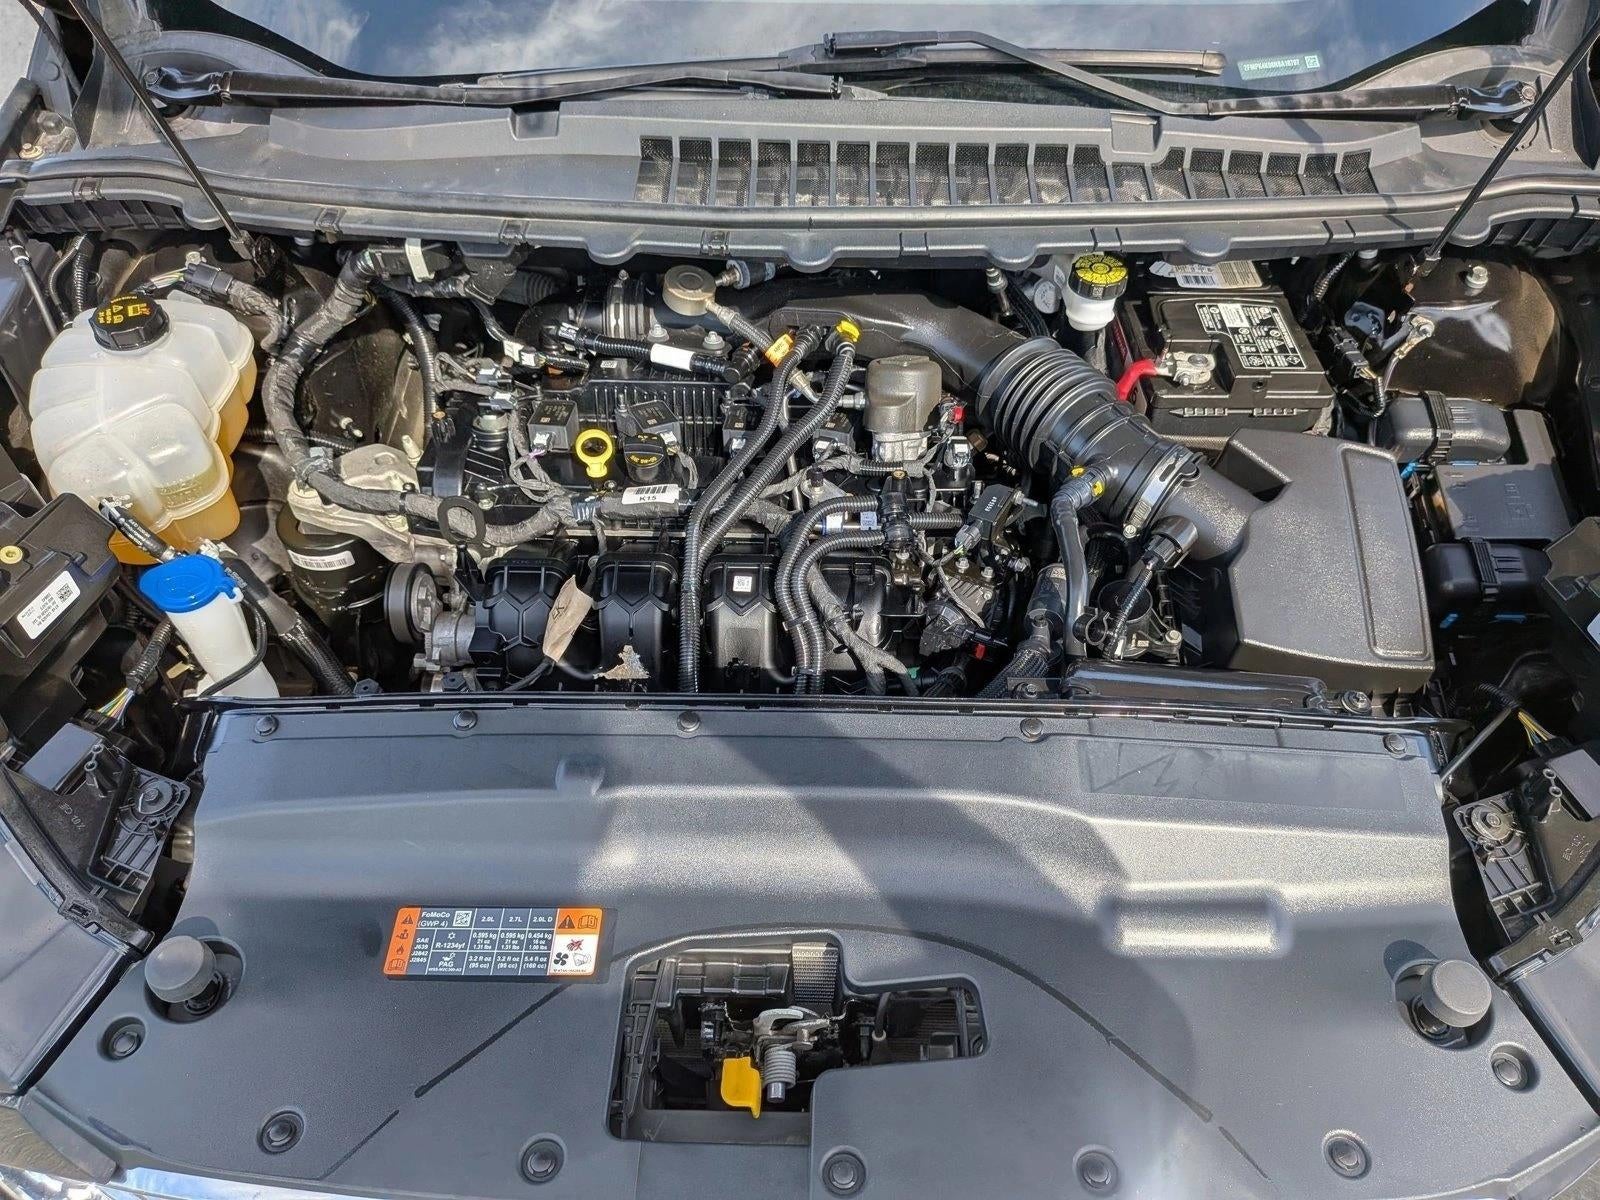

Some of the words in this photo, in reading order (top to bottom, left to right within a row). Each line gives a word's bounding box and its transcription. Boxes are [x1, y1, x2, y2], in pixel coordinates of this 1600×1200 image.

[490, 932, 497, 940] kg
[517, 932, 524, 940] kg
[544, 932, 552, 940] kg
